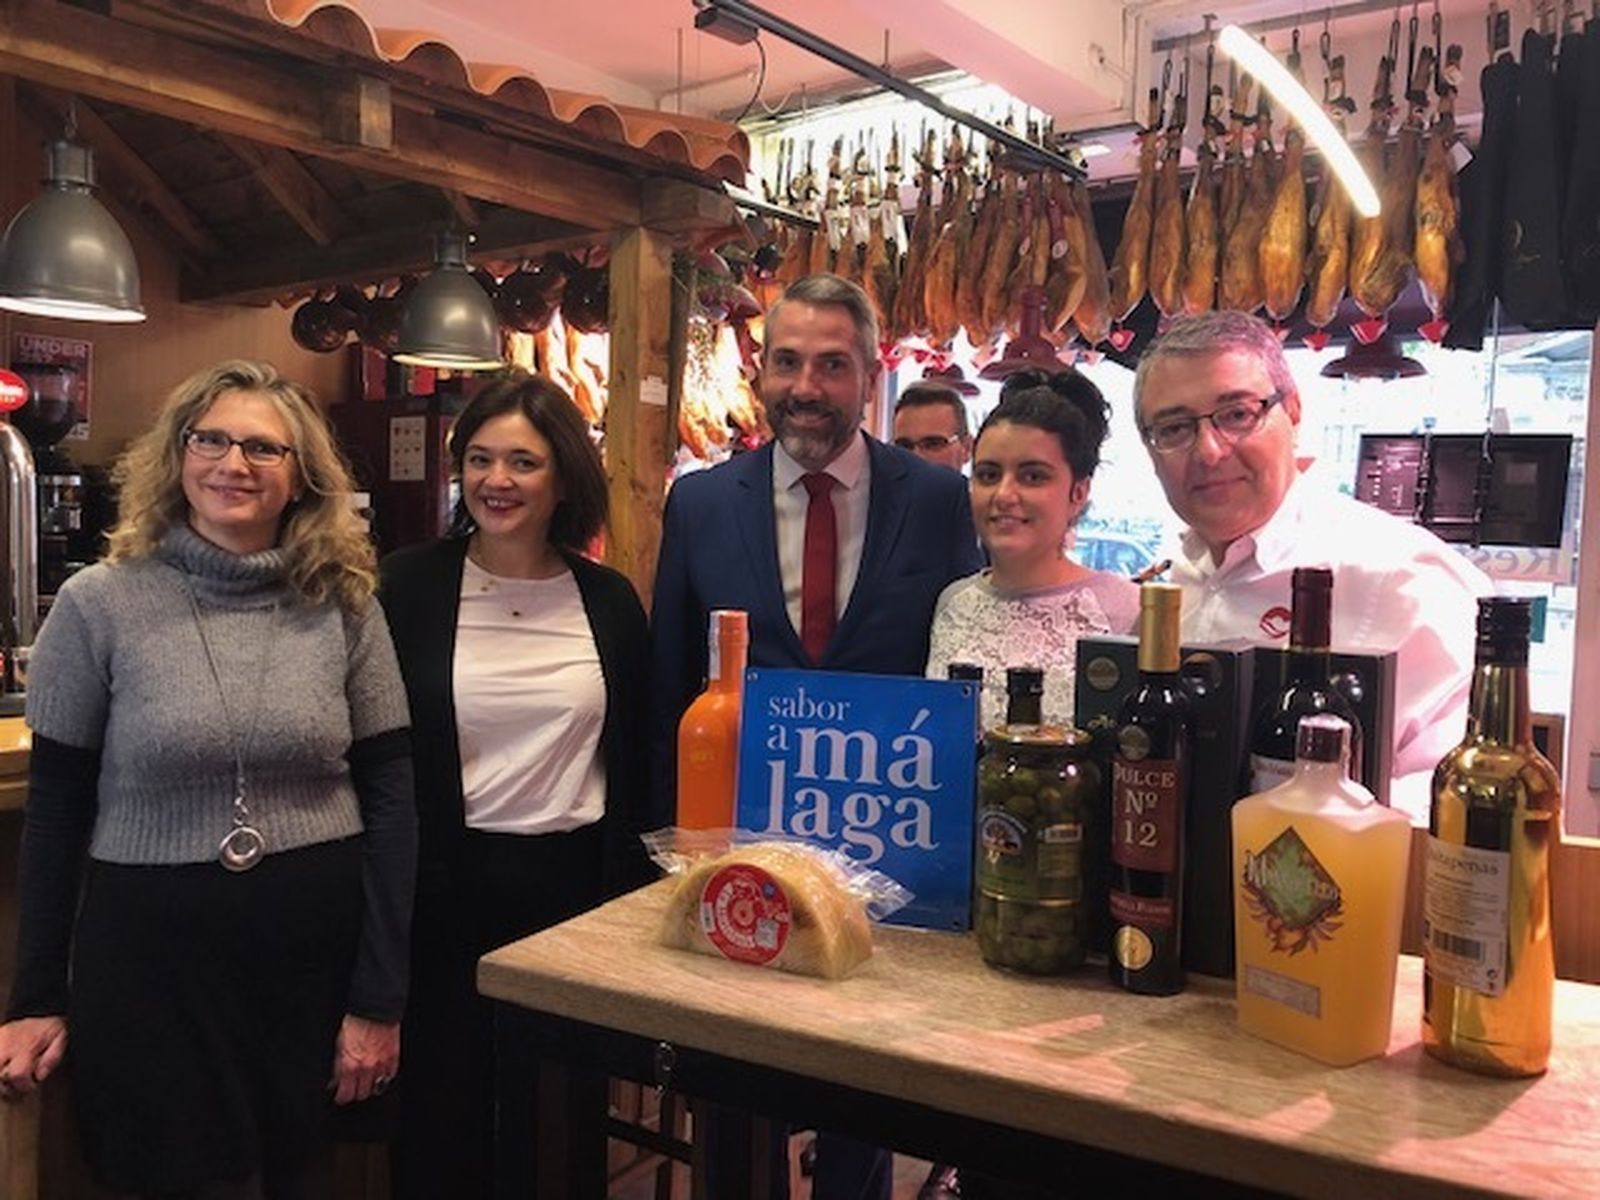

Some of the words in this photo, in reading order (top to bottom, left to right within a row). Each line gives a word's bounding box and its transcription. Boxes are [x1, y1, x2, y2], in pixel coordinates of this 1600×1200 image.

[19, 336, 86, 359] UNDER
[768, 687, 850, 721] sabor
[766, 723, 789, 751] a
[794, 708, 943, 791] má
[1114, 762, 1176, 787] DULCE
[763, 760, 940, 866] laga
[1124, 820, 1157, 847] 12
